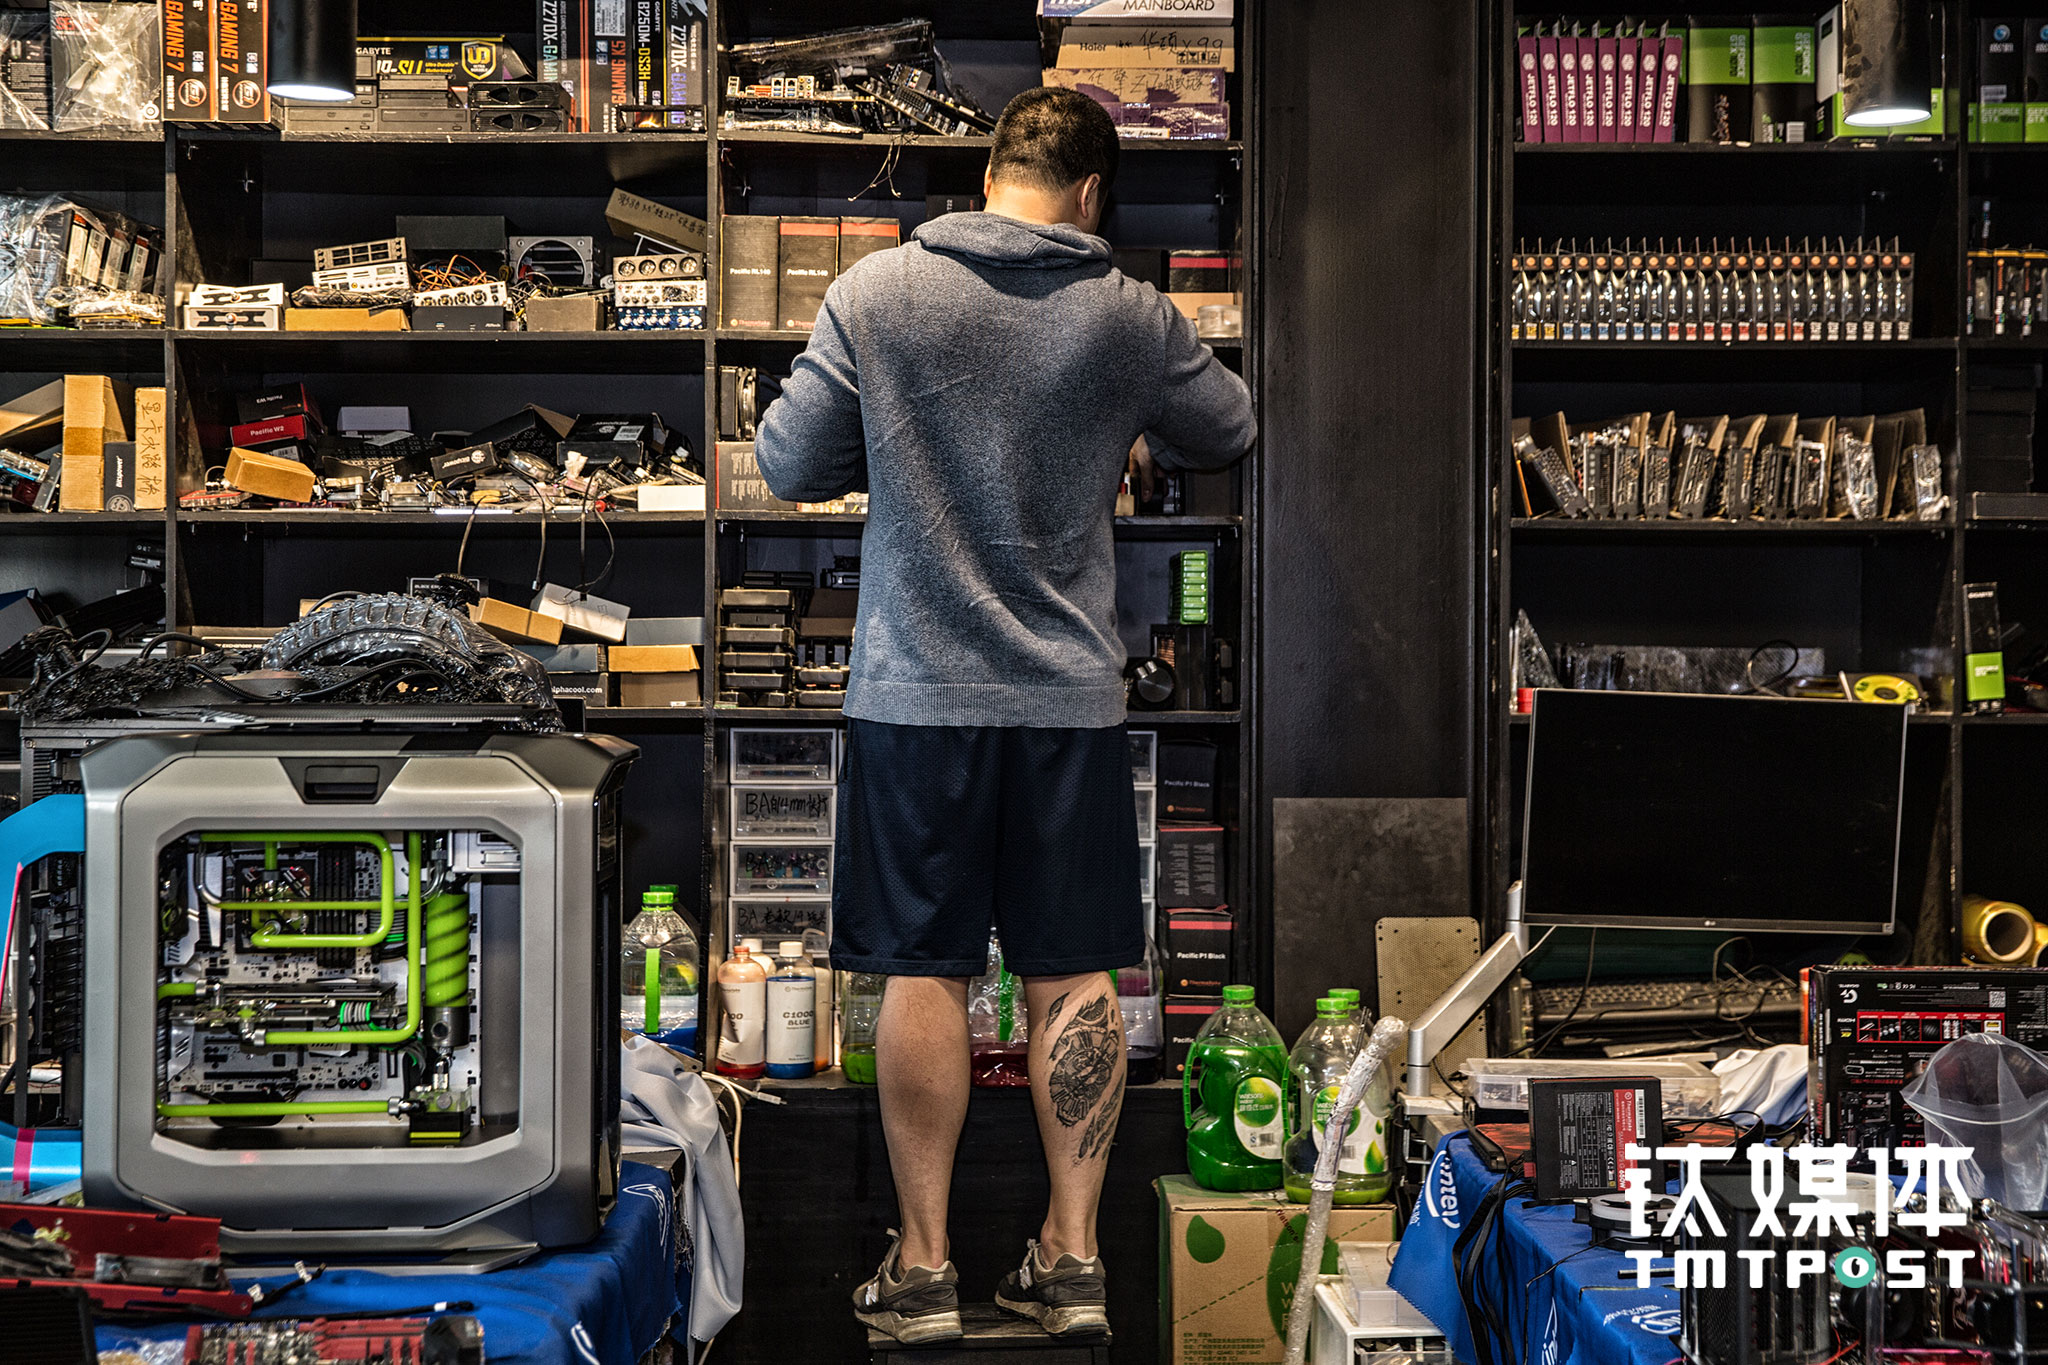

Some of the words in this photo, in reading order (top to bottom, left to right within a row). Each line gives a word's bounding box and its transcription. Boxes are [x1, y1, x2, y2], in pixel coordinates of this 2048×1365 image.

[1123, 0, 1215, 11] MAINBOARD
[166, 1, 184, 58] GAMING
[220, 1, 239, 60] GAMING
[611, 41, 626, 56] K5
[637, 1, 651, 80] B250M-DS3H
[1080, 42, 1106, 51] Haier
[166, 62, 184, 73] 7
[220, 62, 239, 74] 7
[611, 59, 626, 103] GAMING
[1527, 73, 1536, 108] JETFLO
[1547, 74, 1557, 108] JETFLO
[1567, 74, 1576, 108] JETFLO
[1585, 74, 1594, 108] JETFLO
[1605, 74, 1613, 108] JETFLO
[1624, 74, 1633, 108] JETFLO
[1644, 74, 1654, 108] JETFLO
[1665, 74, 1675, 108] JETFLO
[1528, 109, 1538, 126] 120
[1549, 109, 1558, 126] 120
[1567, 109, 1577, 126] 120
[1585, 110, 1594, 126] 120
[1605, 110, 1613, 127] 120
[1624, 110, 1633, 127] 120
[1643, 110, 1652, 127] 120
[1662, 110, 1673, 127] 120
[250, 428, 272, 437] Pacific
[273, 425, 284, 433] W2
[783, 1011, 814, 1019] C1000
[1618, 1169, 1626, 1189] 650W
